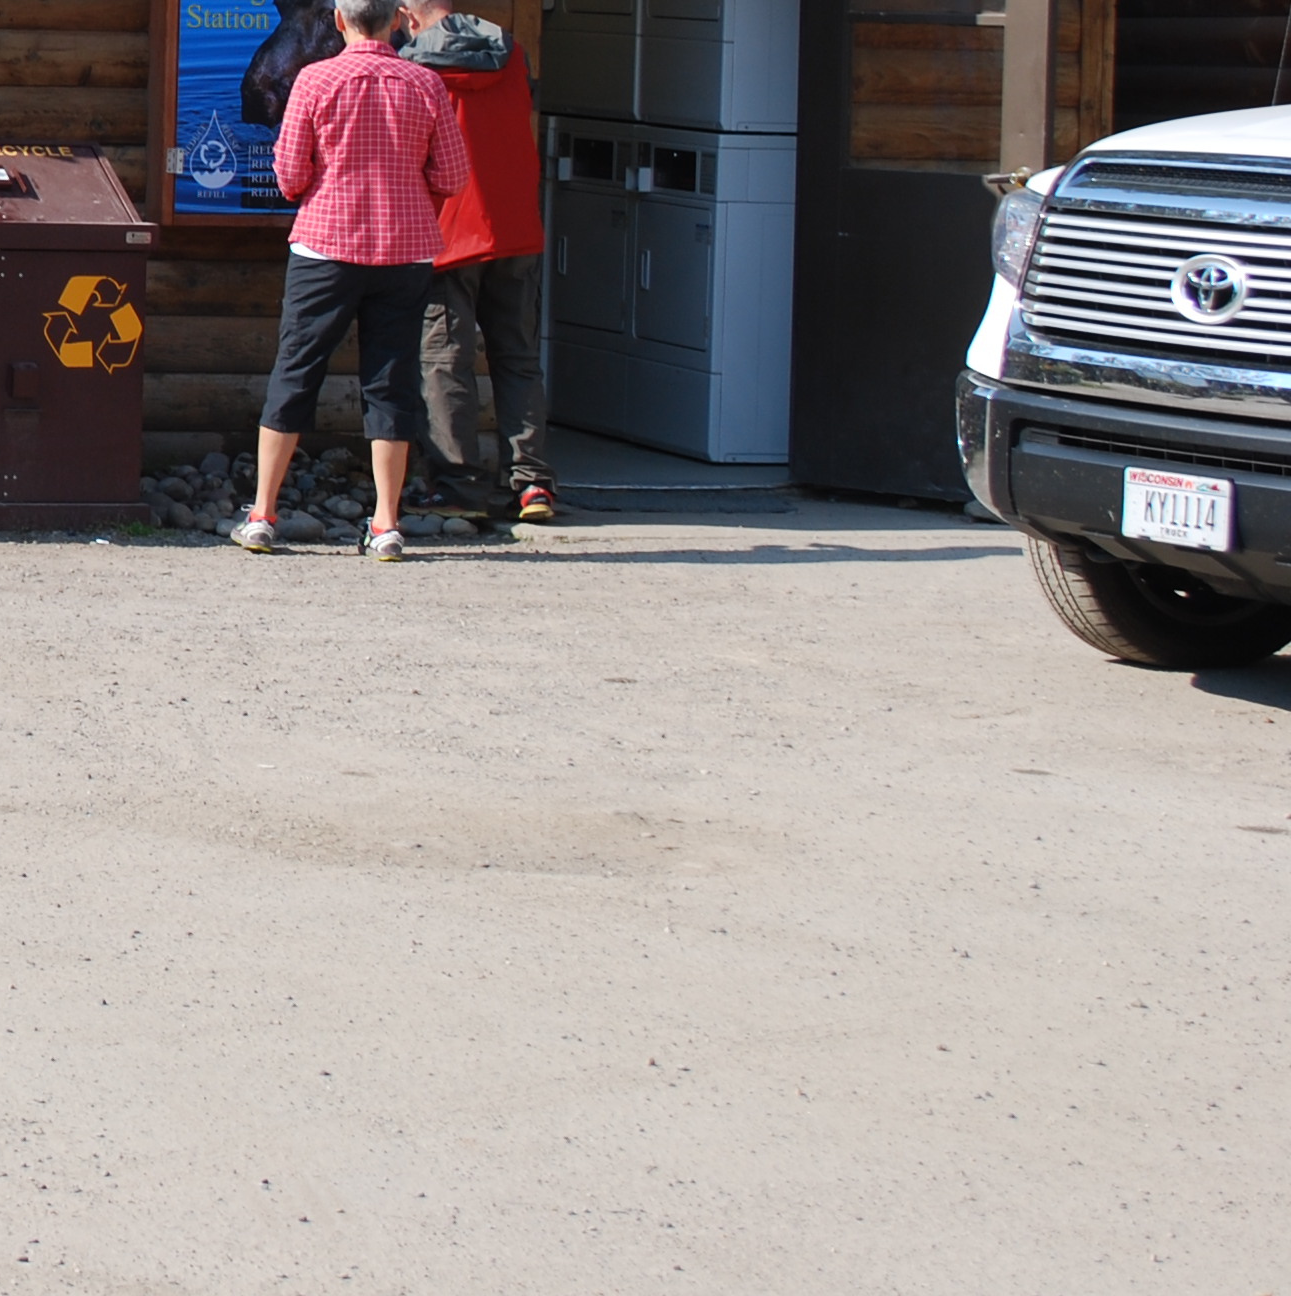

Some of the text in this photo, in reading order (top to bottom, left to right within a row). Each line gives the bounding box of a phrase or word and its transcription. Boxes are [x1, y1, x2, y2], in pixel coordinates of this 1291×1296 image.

[187, 4, 270, 29] Station
[197, 190, 227, 199] REFILL
[1129, 470, 1183, 487] WISCONSIN
[1144, 489, 1216, 531] KY1114
[1160, 527, 1188, 537] TRUCK
